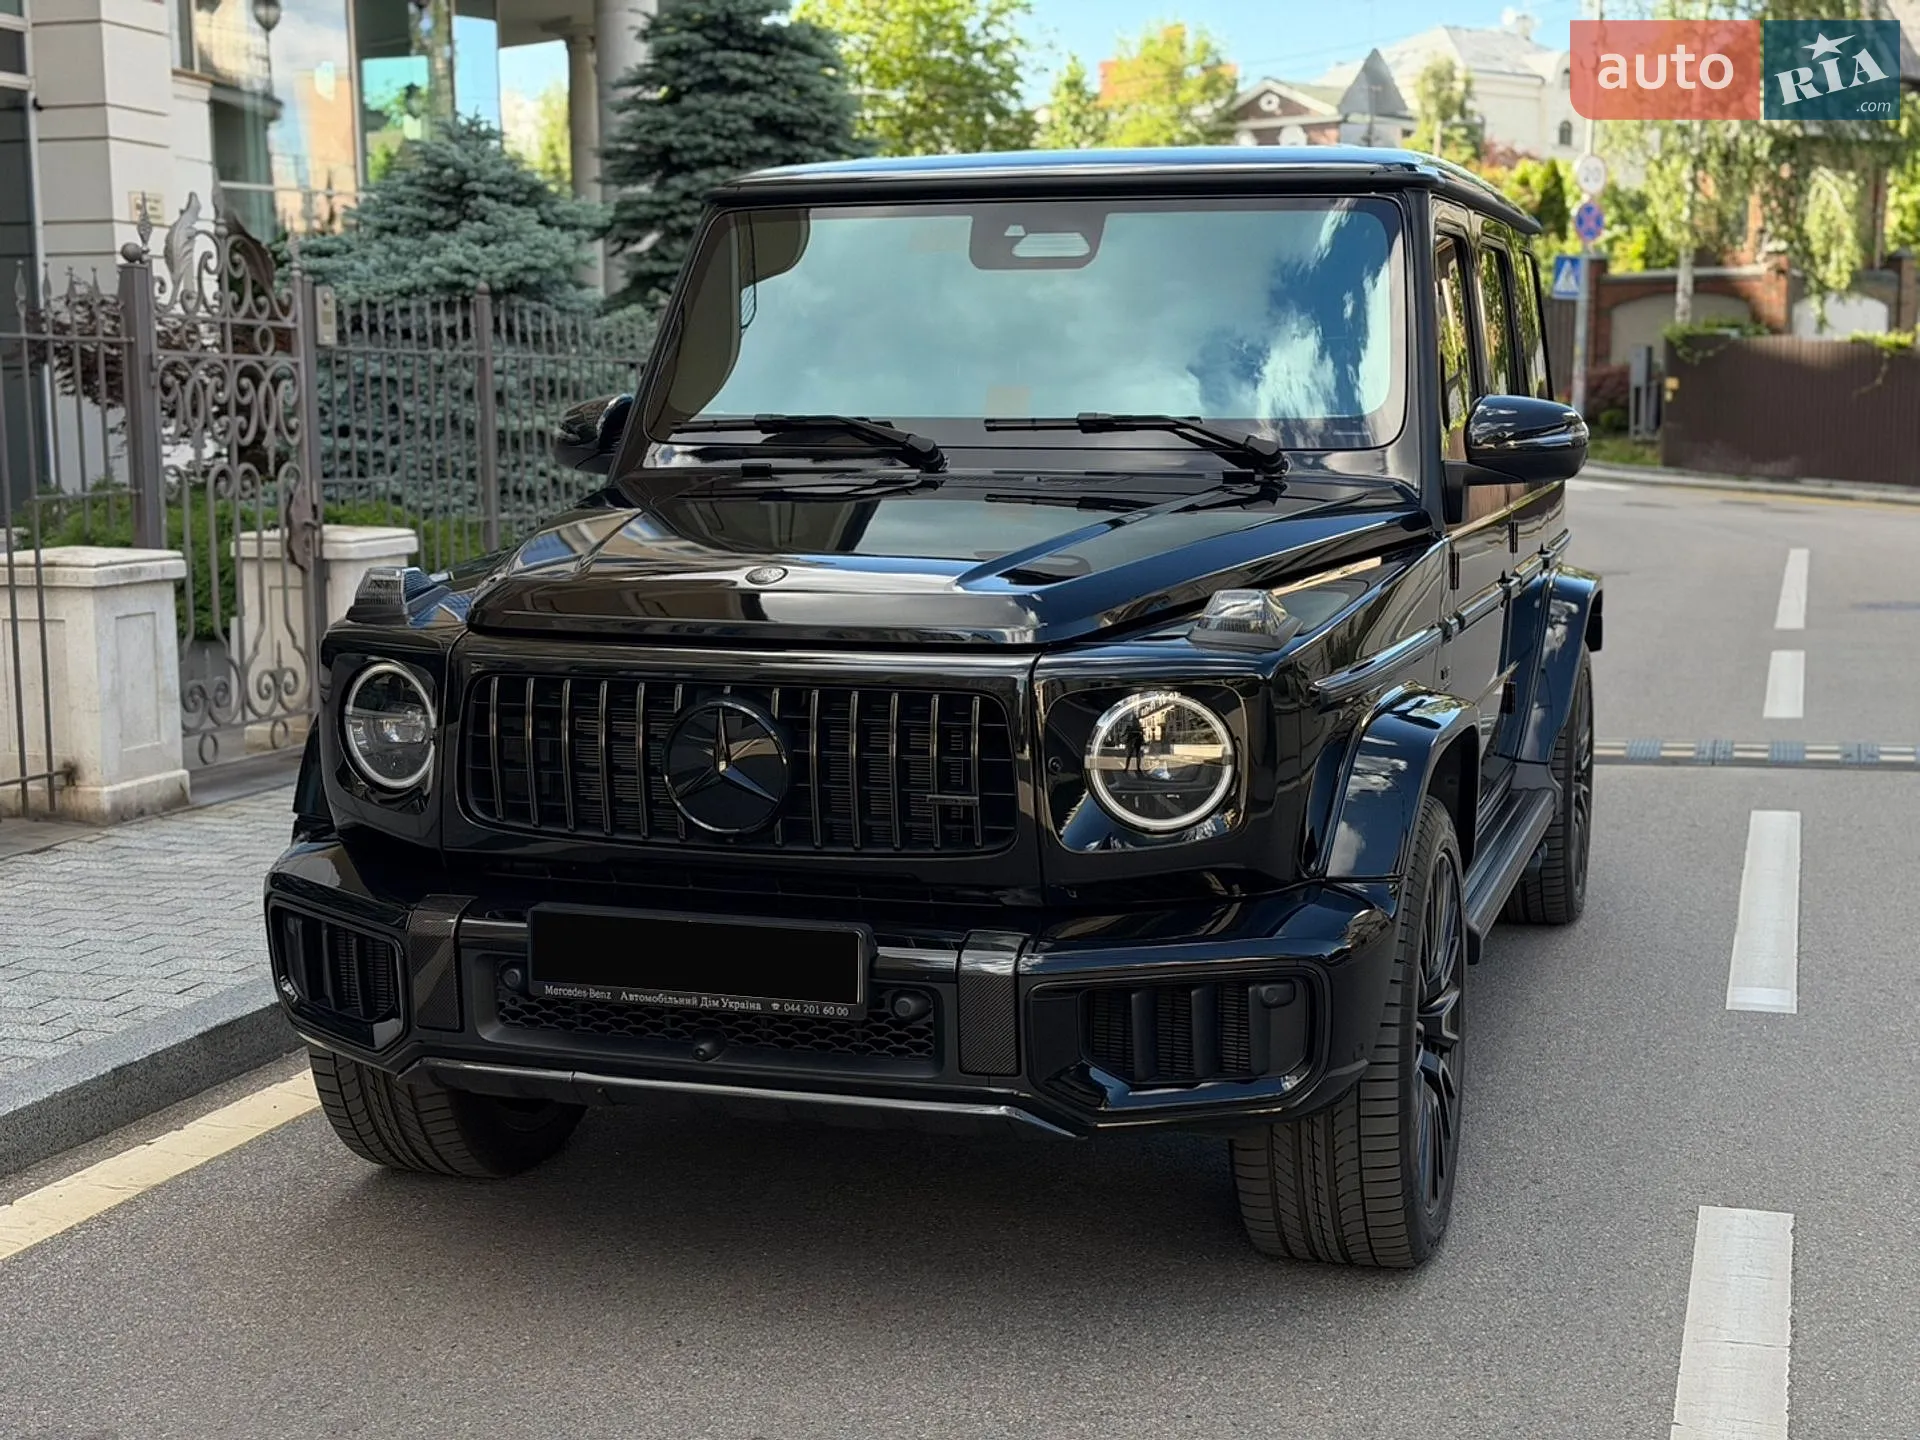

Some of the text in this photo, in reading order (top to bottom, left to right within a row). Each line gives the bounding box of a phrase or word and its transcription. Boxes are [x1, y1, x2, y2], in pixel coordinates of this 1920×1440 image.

[620, 991, 762, 1012] Автомобільний Дім Україна
[783, 1003, 849, 1017] 044 201 60 00
